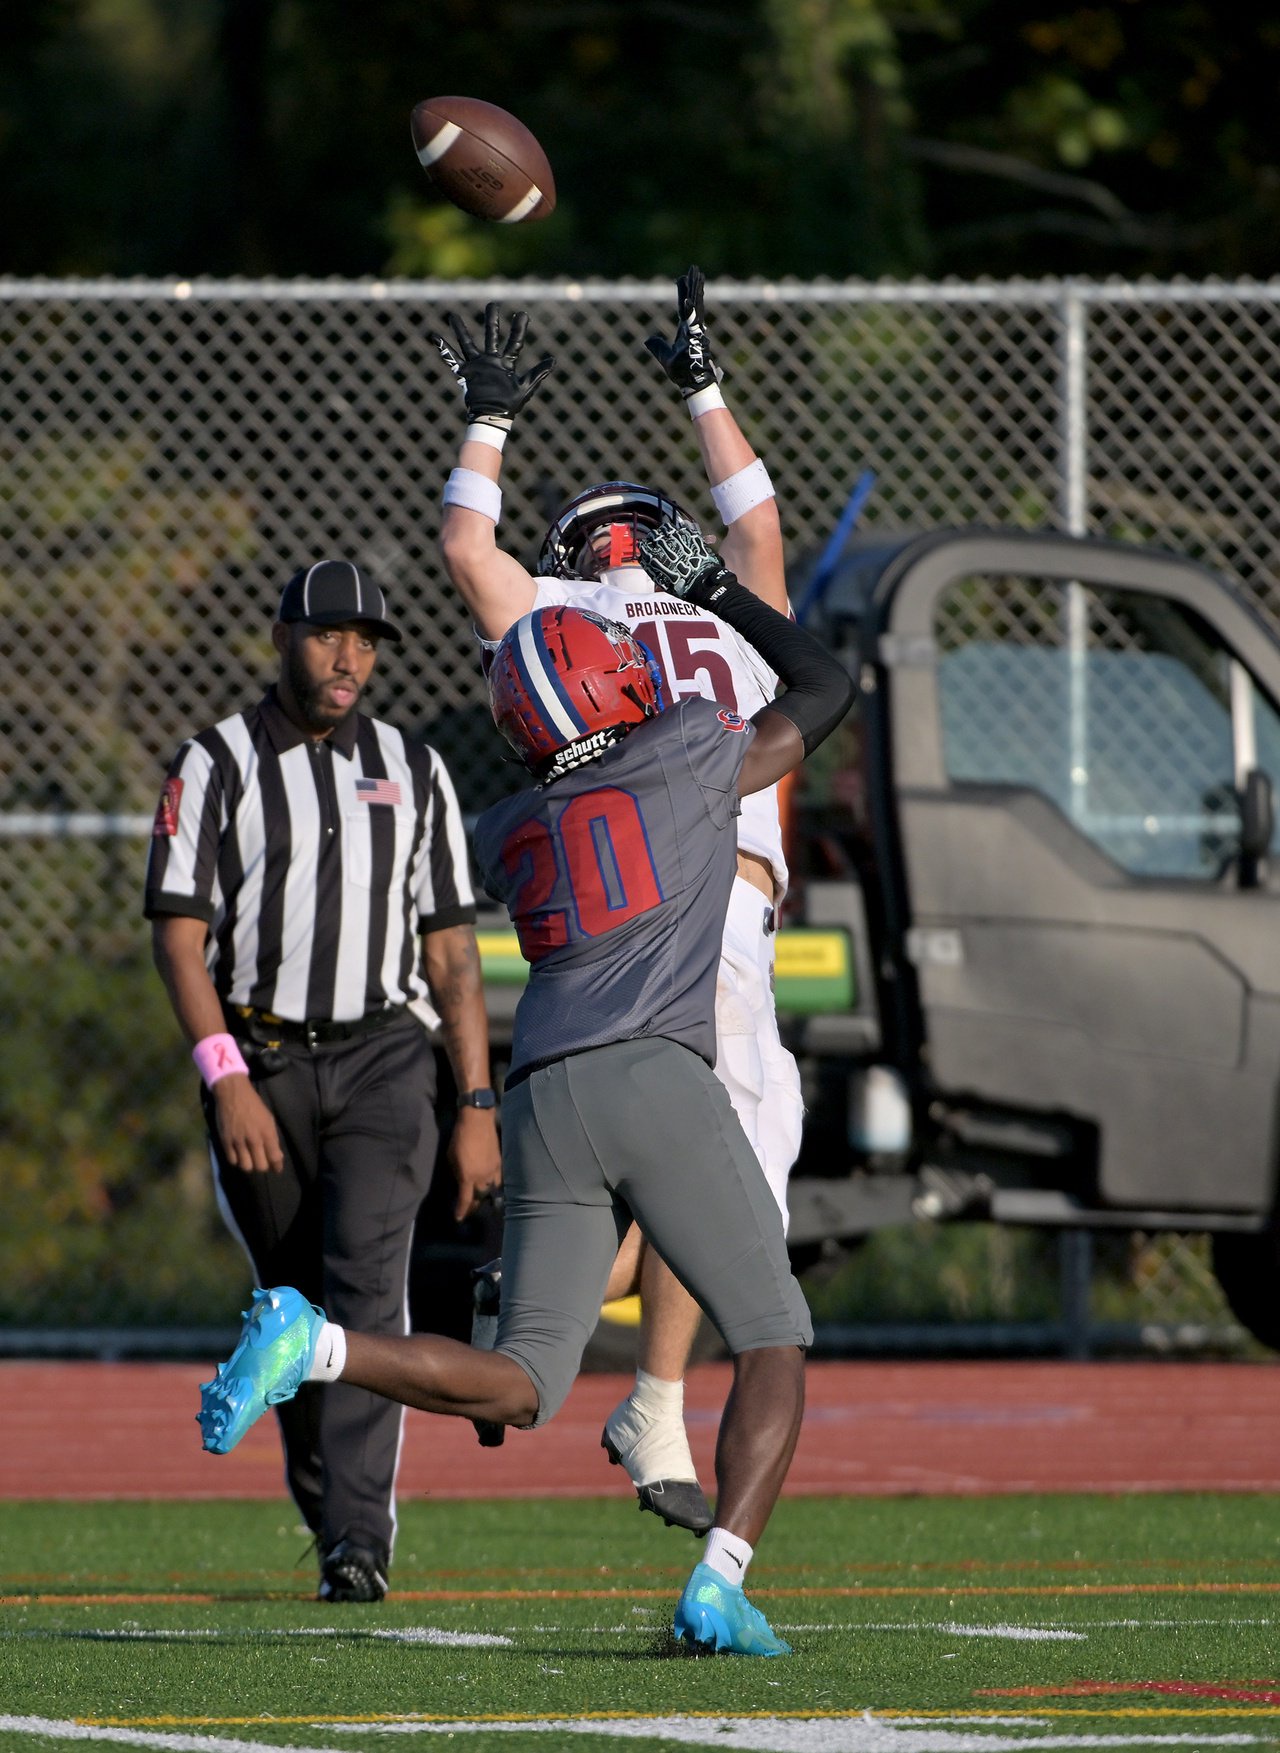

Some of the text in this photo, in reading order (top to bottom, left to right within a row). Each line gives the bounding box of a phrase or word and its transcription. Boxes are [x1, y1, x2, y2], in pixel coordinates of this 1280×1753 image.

[469, 166, 504, 191] GST
[625, 602, 701, 618] BROADNECK
[630, 620, 738, 714] 15
[555, 731, 607, 765] schutt
[501, 783, 666, 964] 20
